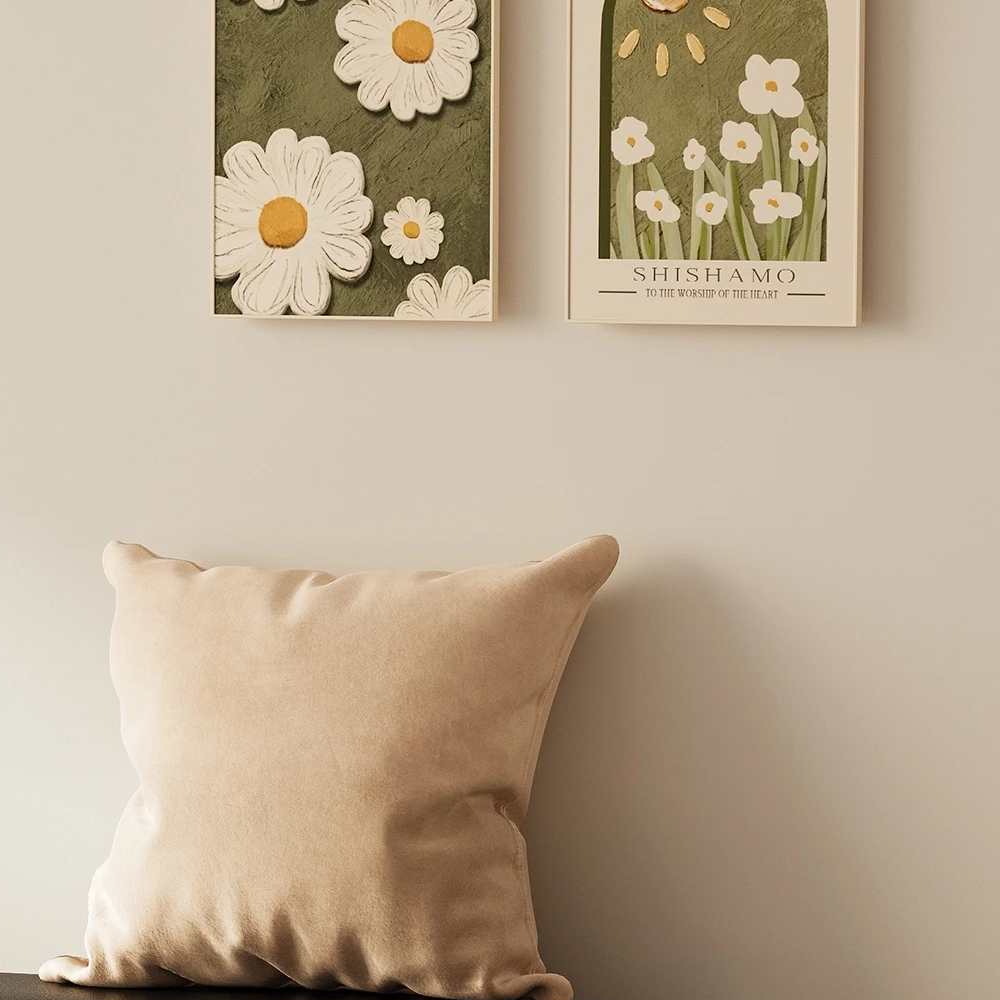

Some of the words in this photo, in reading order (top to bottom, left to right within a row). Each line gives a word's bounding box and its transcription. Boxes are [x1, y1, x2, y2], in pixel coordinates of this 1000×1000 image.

[633, 266, 796, 284] SHISHAMO
[646, 288, 657, 298] TO
[659, 288, 676, 298] THE
[677, 288, 717, 299] WORSHIP
[718, 289, 731, 299] OF
[732, 289, 749, 299] THE
[750, 289, 779, 300] HEART
